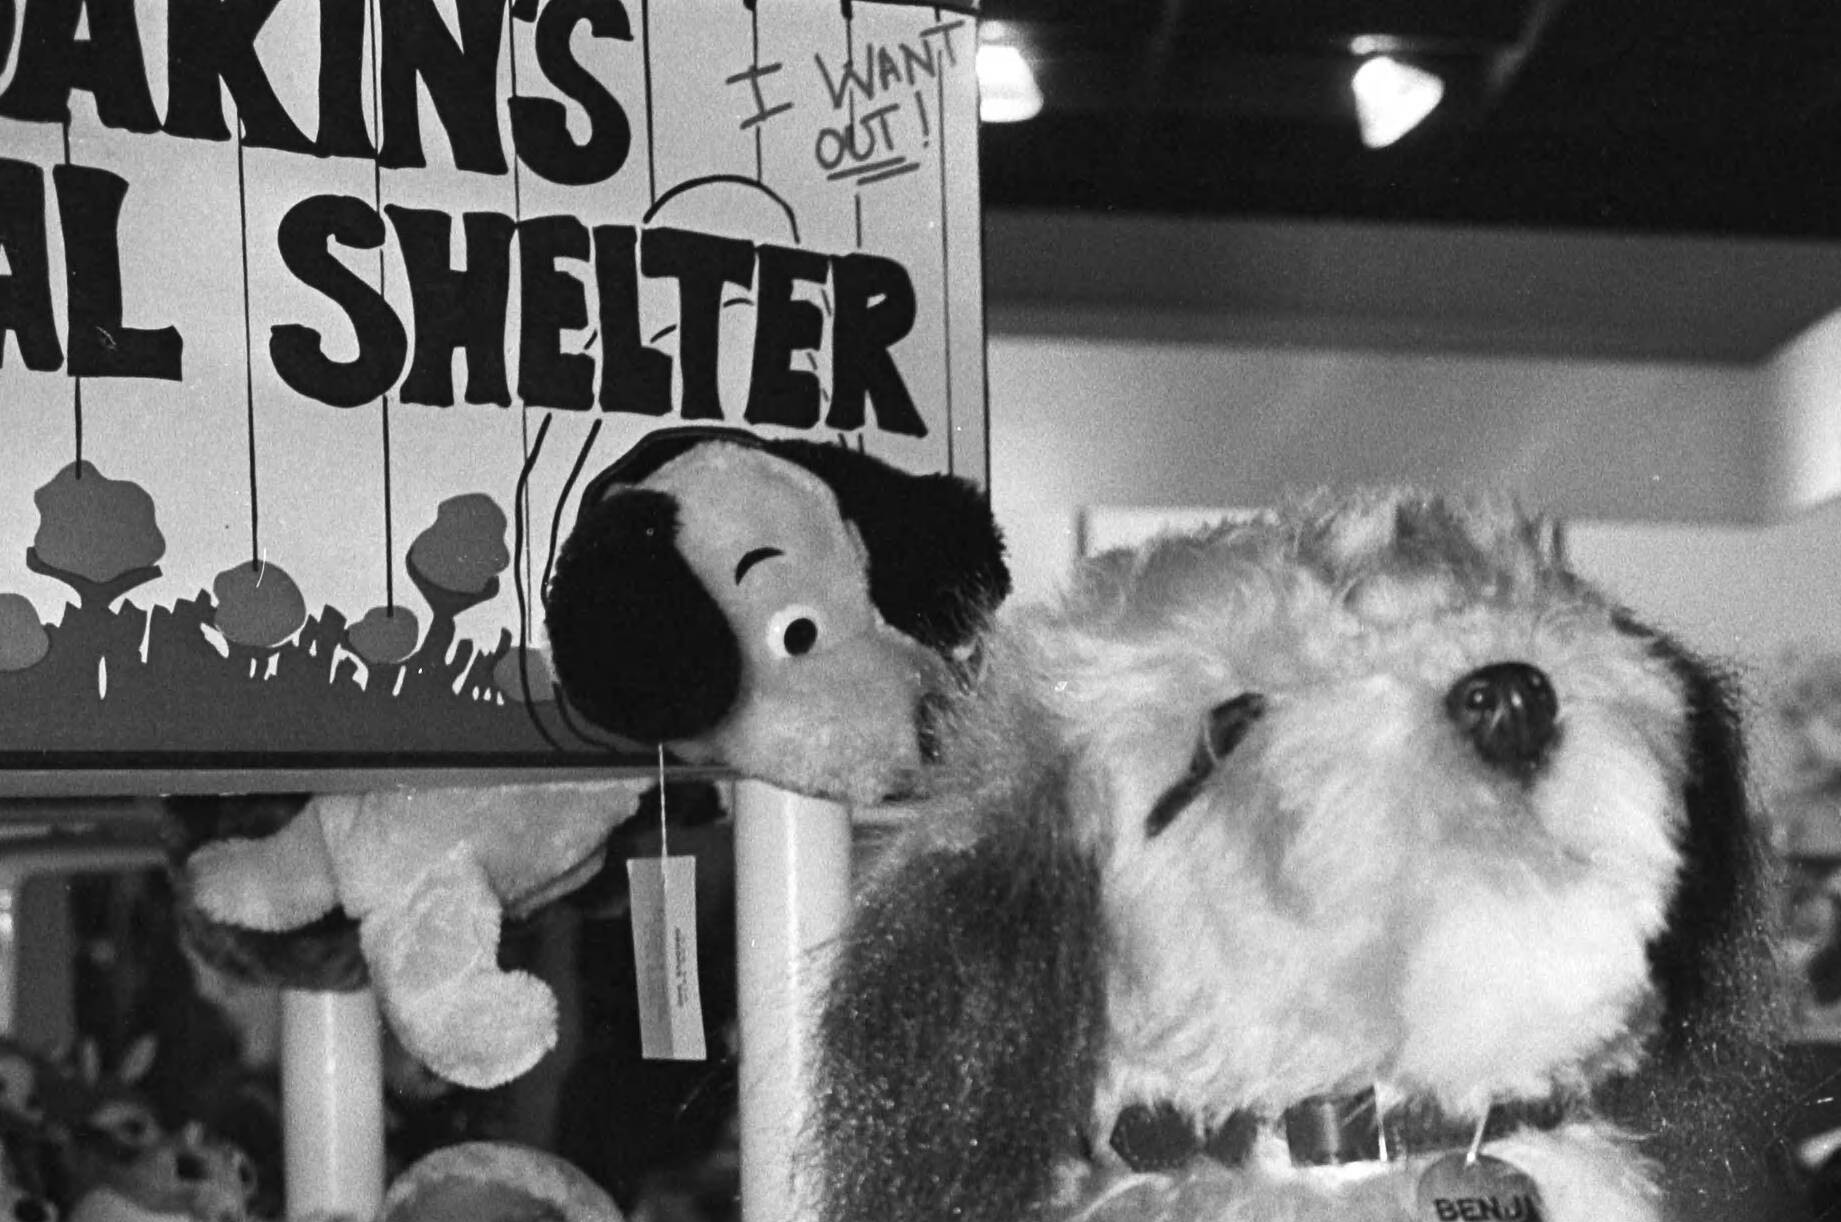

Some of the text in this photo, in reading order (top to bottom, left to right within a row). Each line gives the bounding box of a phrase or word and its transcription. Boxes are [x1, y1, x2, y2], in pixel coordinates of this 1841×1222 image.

[0, 0, 633, 185] AKIN'S
[727, 20, 965, 130] I WANT
[815, 90, 929, 169] OUT!
[270, 195, 928, 436] SHELTER
[1434, 1196, 1537, 1222] BENJI
